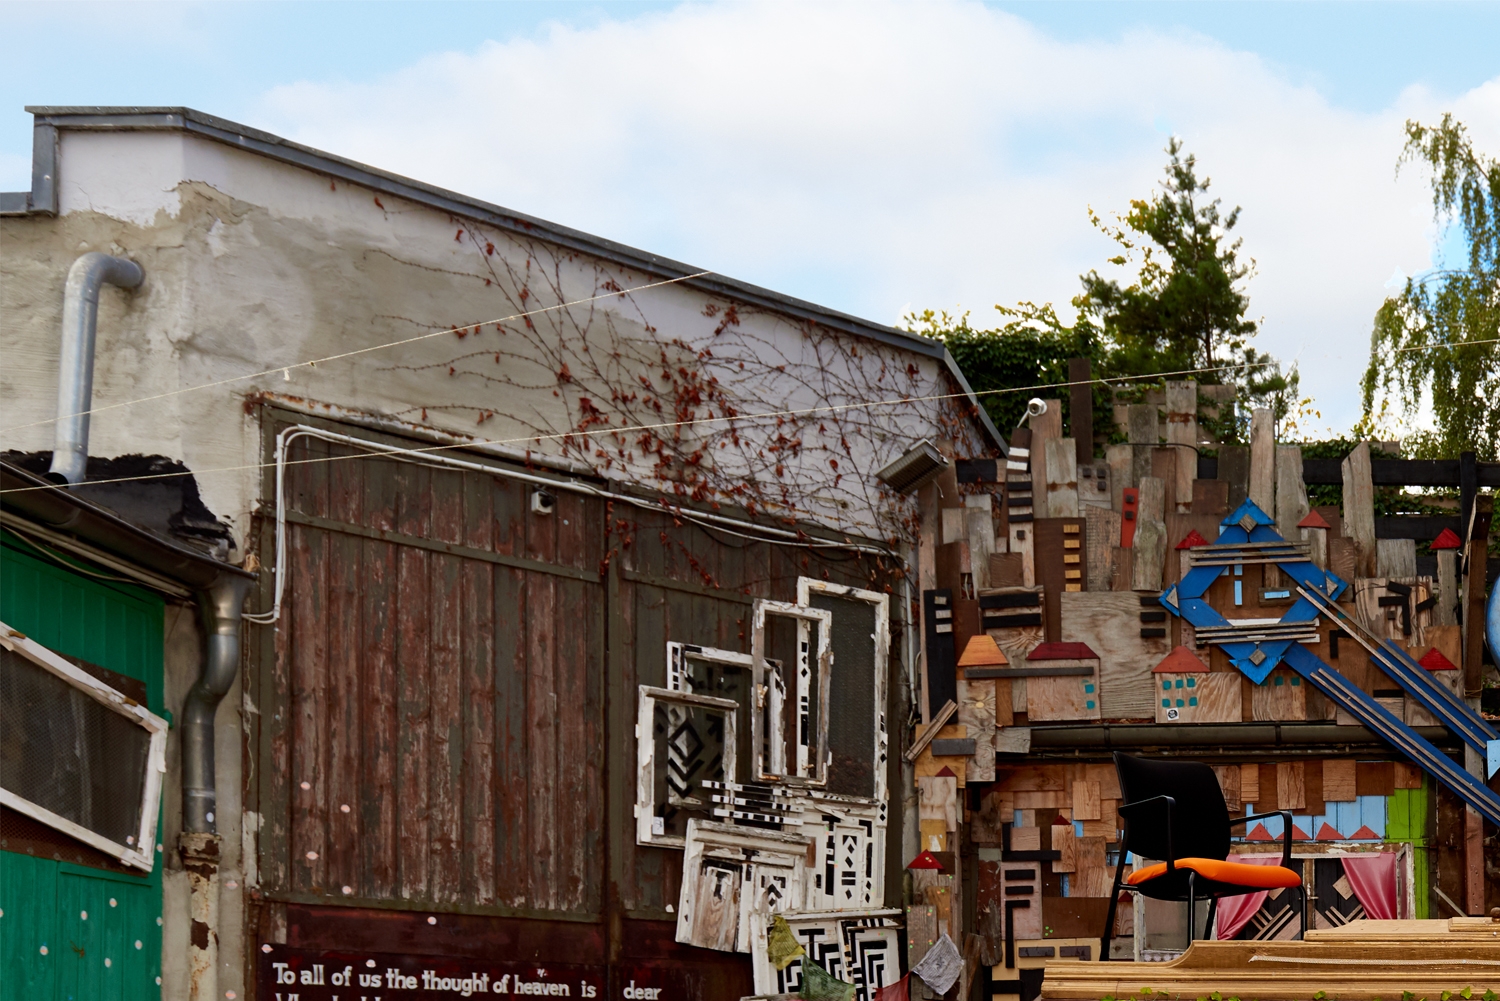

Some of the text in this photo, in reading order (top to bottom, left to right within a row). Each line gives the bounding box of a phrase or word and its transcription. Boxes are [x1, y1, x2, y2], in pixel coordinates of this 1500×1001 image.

[273, 963, 662, 1000] To all of us the thought of heaven is dear
